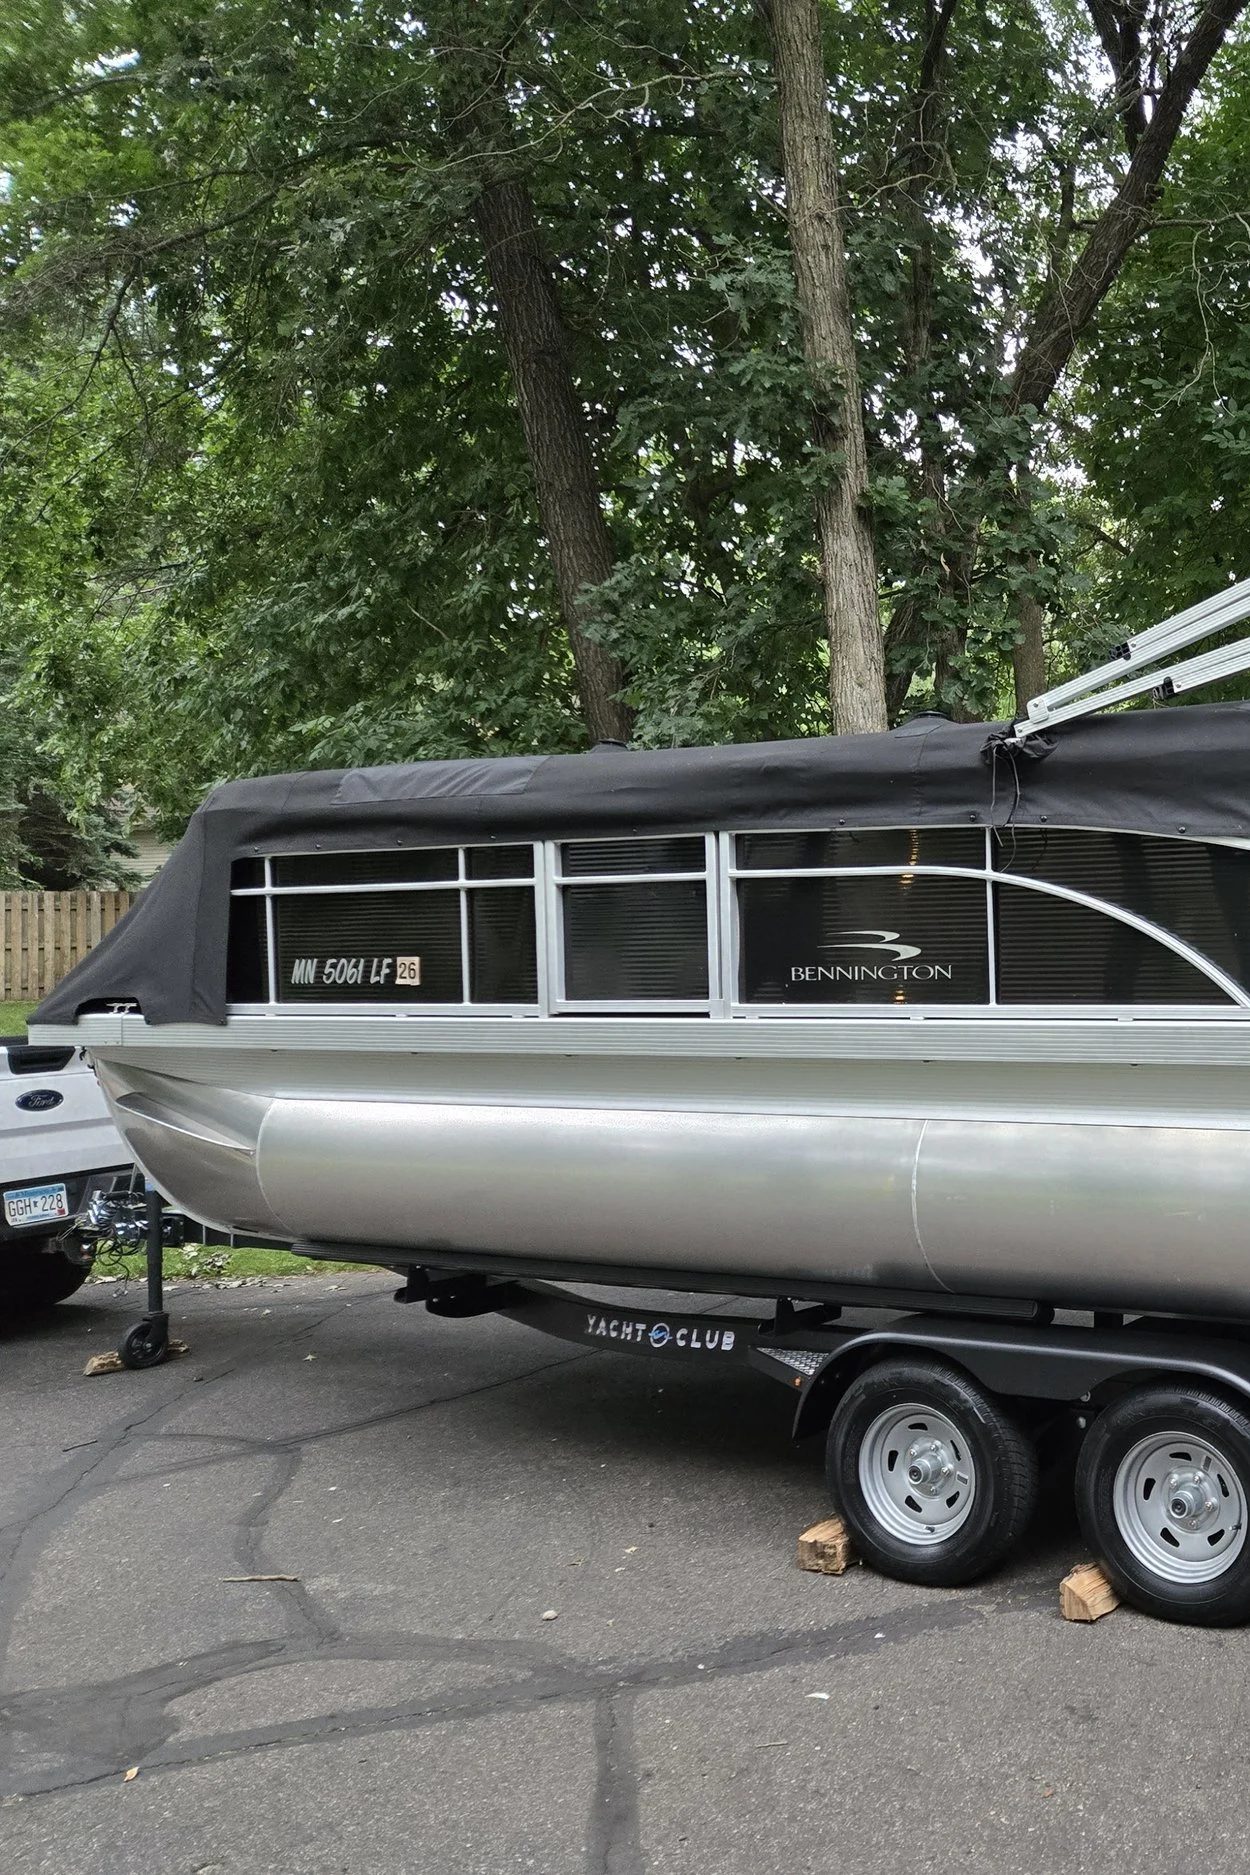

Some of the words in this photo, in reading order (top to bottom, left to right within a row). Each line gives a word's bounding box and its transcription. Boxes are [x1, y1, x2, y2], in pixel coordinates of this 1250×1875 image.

[291, 958, 318, 984] MN
[323, 958, 364, 984] 5061
[370, 958, 392, 984] LF
[398, 962, 416, 980] 26
[791, 965, 952, 981] BENNINGTON
[8, 1198, 32, 1217] GGH
[41, 1194, 63, 1212] 228
[587, 1314, 647, 1342] YACHT
[675, 1328, 735, 1351] CLUB
